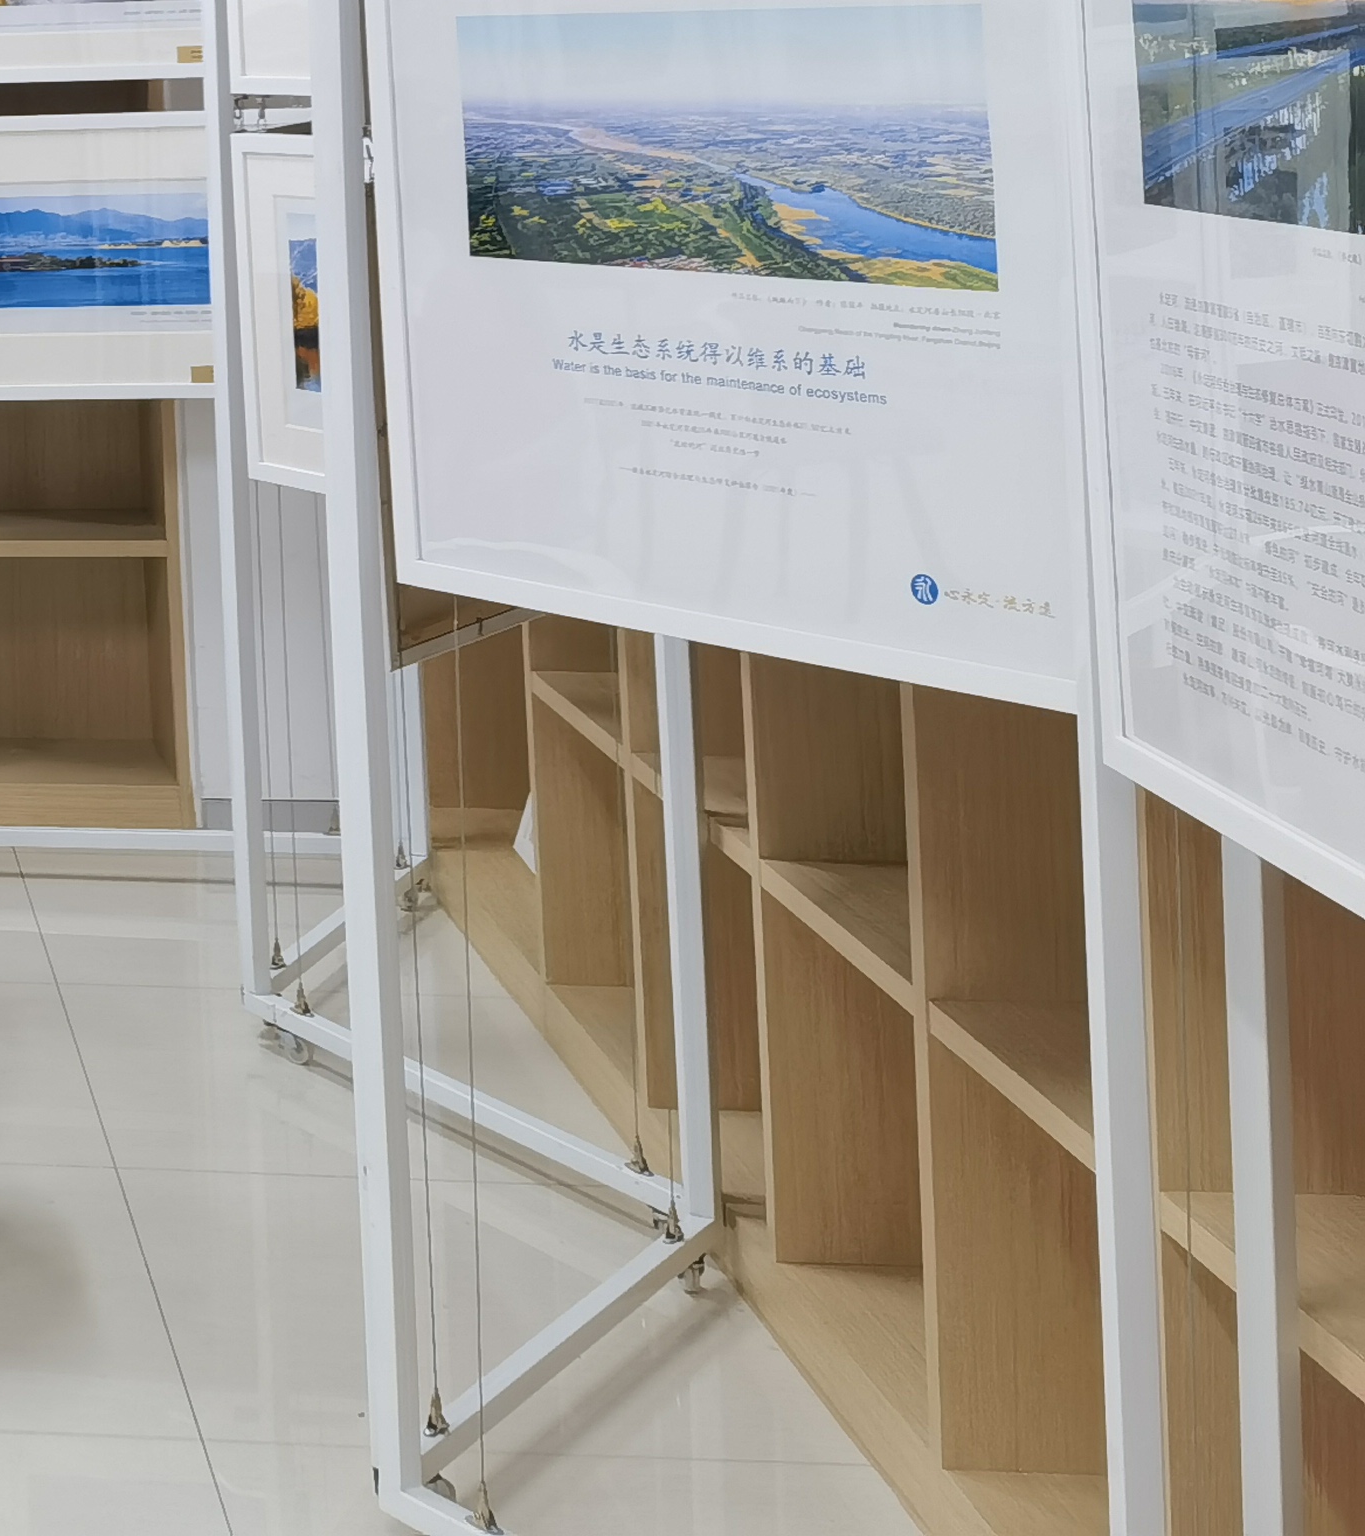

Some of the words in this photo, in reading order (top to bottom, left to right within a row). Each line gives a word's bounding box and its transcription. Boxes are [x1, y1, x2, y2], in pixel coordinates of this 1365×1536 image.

[568, 329, 867, 380] 水是生态系统得以维系的基础
[552, 357, 586, 374] Water
[589, 362, 600, 375] is
[603, 362, 622, 377] the
[625, 365, 657, 381] basis
[660, 368, 678, 383] for
[681, 371, 702, 385] the
[706, 375, 785, 396] maintenance
[788, 383, 803, 397] of
[806, 386, 887, 406] ecosystems
